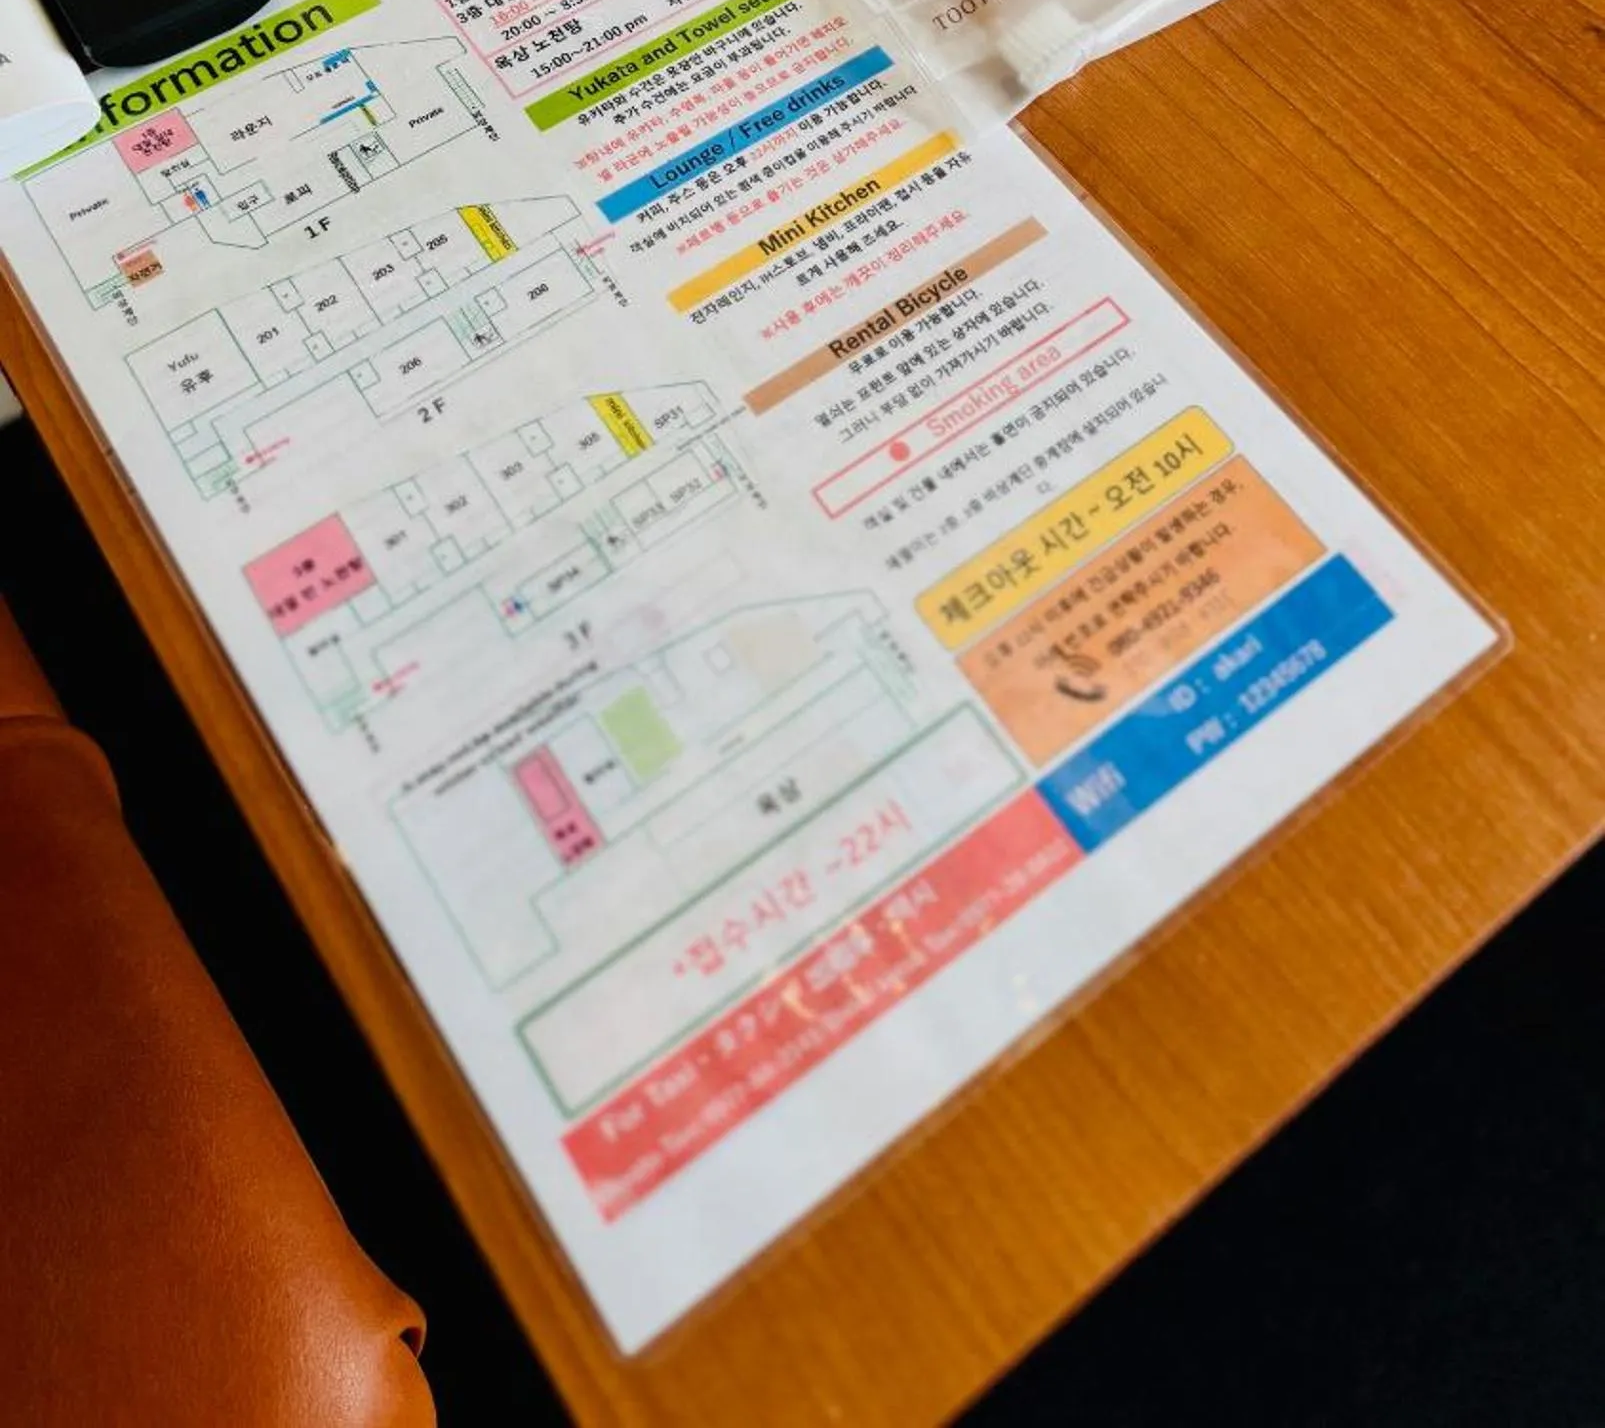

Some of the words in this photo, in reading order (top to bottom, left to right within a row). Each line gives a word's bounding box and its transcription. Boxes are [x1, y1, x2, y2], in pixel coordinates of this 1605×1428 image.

[499, 14, 543, 41] 20:00
[622, 13, 652, 34] pm
[626, 72, 667, 99] 수건은
[749, 0, 804, 32] 있습니다.
[80, 2, 335, 140] formation
[491, 44, 533, 72] 옥상
[567, 58, 642, 103] Yukata
[637, 38, 679, 65] and
[675, 7, 738, 45] Towel
[406, 105, 445, 128] Private
[611, 105, 641, 126] 추가
[647, 139, 727, 189] Lounge
[737, 105, 786, 138] Free
[782, 71, 846, 112] drinks
[633, 199, 670, 225] 커피,
[665, 184, 697, 207] 주스
[694, 169, 723, 190] 등은
[719, 154, 749, 176] 오후
[796, 112, 825, 132] 이용
[821, 76, 889, 118] 가능합니다.
[711, 186, 739, 207] 있는
[838, 108, 876, 133] 주시기
[893, 180, 923, 202] 접시
[919, 165, 948, 187] 등을
[943, 149, 974, 172] 자유
[67, 196, 110, 221] Private
[756, 220, 807, 256] Mini
[802, 175, 883, 228] Kitchen
[371, 263, 395, 280] 203
[820, 240, 863, 270] 사용해
[313, 294, 339, 312] 202
[826, 308, 898, 360] Rental
[892, 262, 972, 318] Bicycle
[894, 352, 926, 376] 앞에
[922, 334, 953, 359] 있는
[949, 309, 992, 341] 상자에
[986, 275, 1047, 317] 있습니다.
[255, 326, 280, 344] 201
[847, 344, 890, 376] 무료로
[887, 326, 918, 351] 이용
[912, 285, 985, 334] 가능합니다.
[166, 349, 200, 373] Yufu
[398, 356, 423, 374] 206
[906, 374, 938, 399] 없이
[924, 371, 1019, 440] Smoking
[1012, 342, 1064, 382] area
[934, 545, 1043, 630] 체크아웃
[1032, 510, 1092, 561] 시간
[1098, 465, 1156, 513] 오전
[1146, 431, 1205, 479] 10시
[1063, 760, 1130, 820] Wifi
